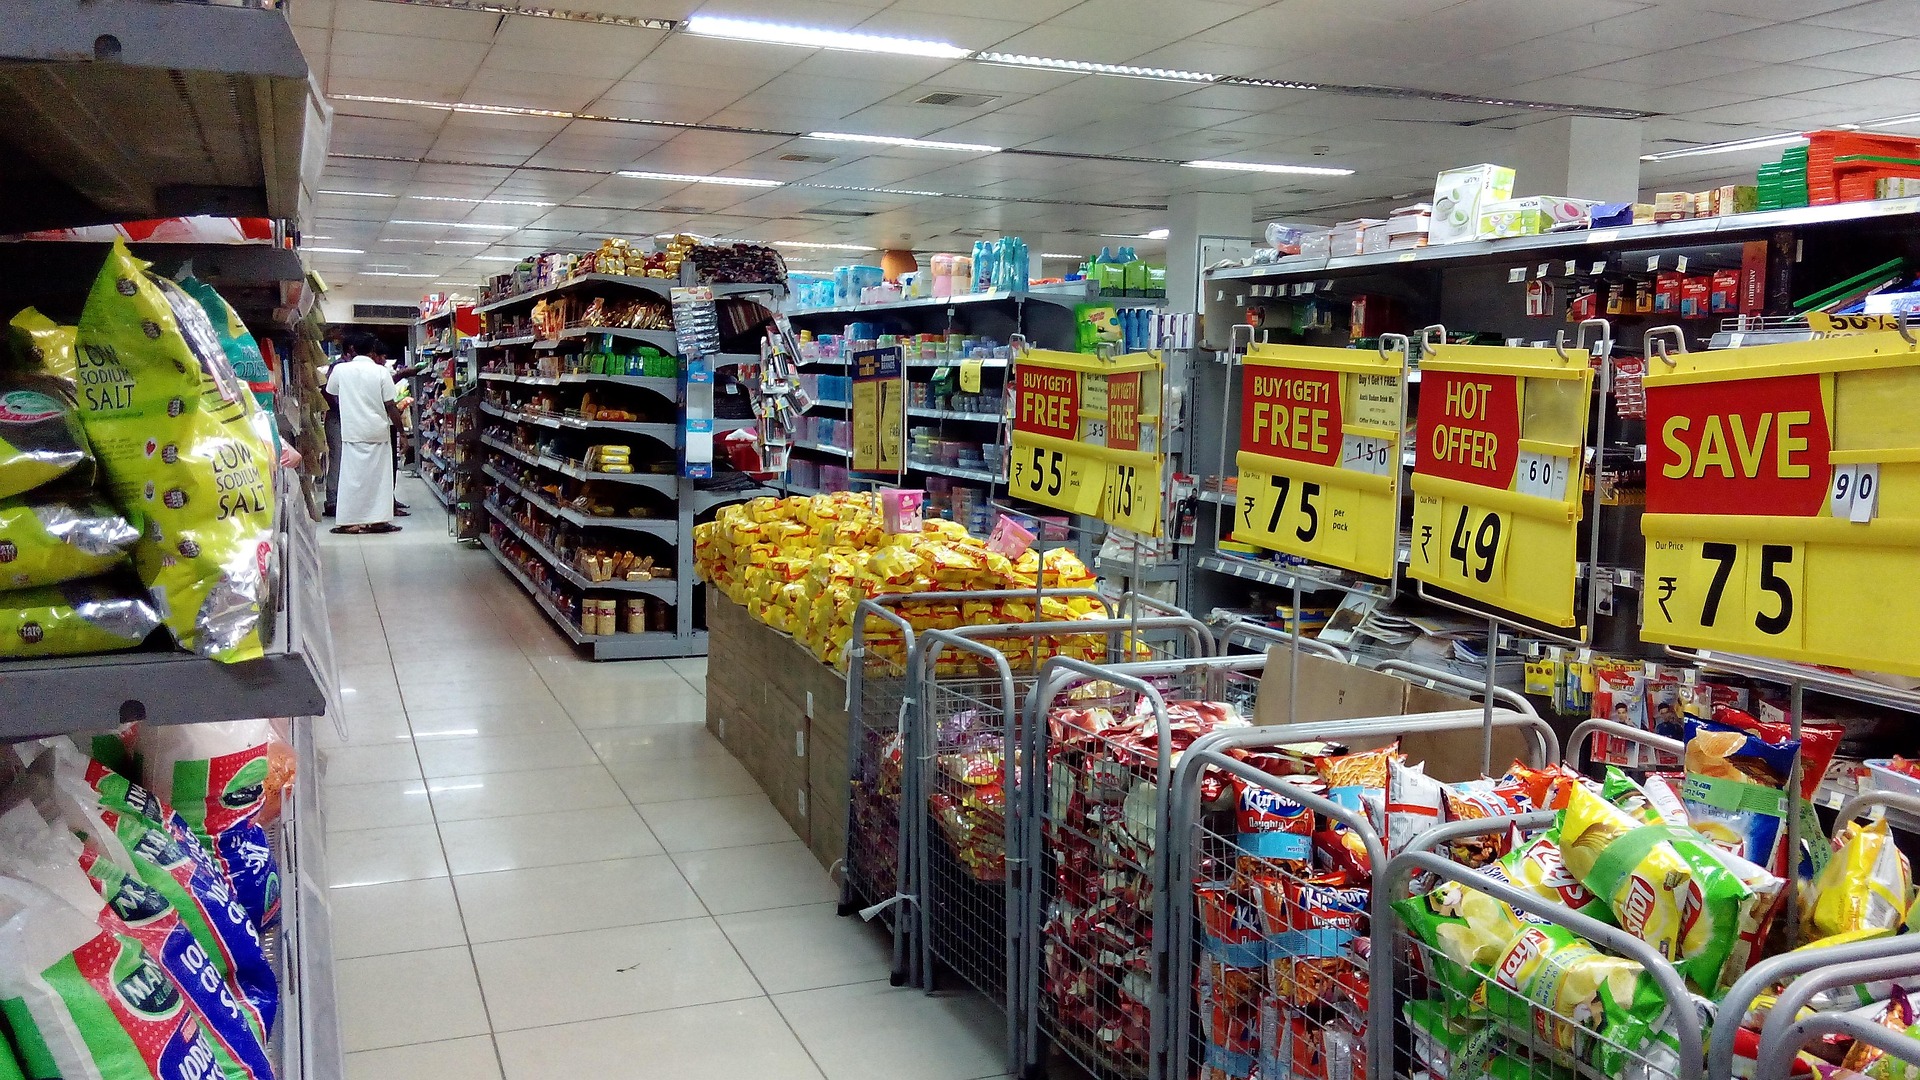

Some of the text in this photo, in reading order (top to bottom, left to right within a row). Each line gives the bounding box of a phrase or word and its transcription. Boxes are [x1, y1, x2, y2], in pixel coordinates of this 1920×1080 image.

[74, 344, 120, 368] LOW
[80, 368, 133, 385] SODIUM
[86, 384, 134, 411] SALT
[1022, 392, 1071, 431] FREE
[1445, 380, 1493, 421] HOT
[1110, 404, 1135, 441] FREE
[1252, 401, 1329, 454] FREE
[212, 441, 252, 473] LOW
[1356, 442, 1386, 466] 150
[1432, 424, 1498, 471] OFFER
[1661, 410, 1811, 479] SAVE
[216, 467, 261, 493] SODIUM
[1030, 447, 1063, 496] 55
[1529, 460, 1551, 485] 60
[1835, 473, 1874, 500] 90
[217, 484, 267, 520] SALT
[1116, 465, 1135, 517] 75
[1267, 474, 1320, 543] 75
[1332, 522, 1348, 531] pack
[1334, 509, 1345, 518] per
[1450, 505, 1501, 583] 49
[1655, 540, 1684, 551] Our Price
[1700, 542, 1793, 635] 75
